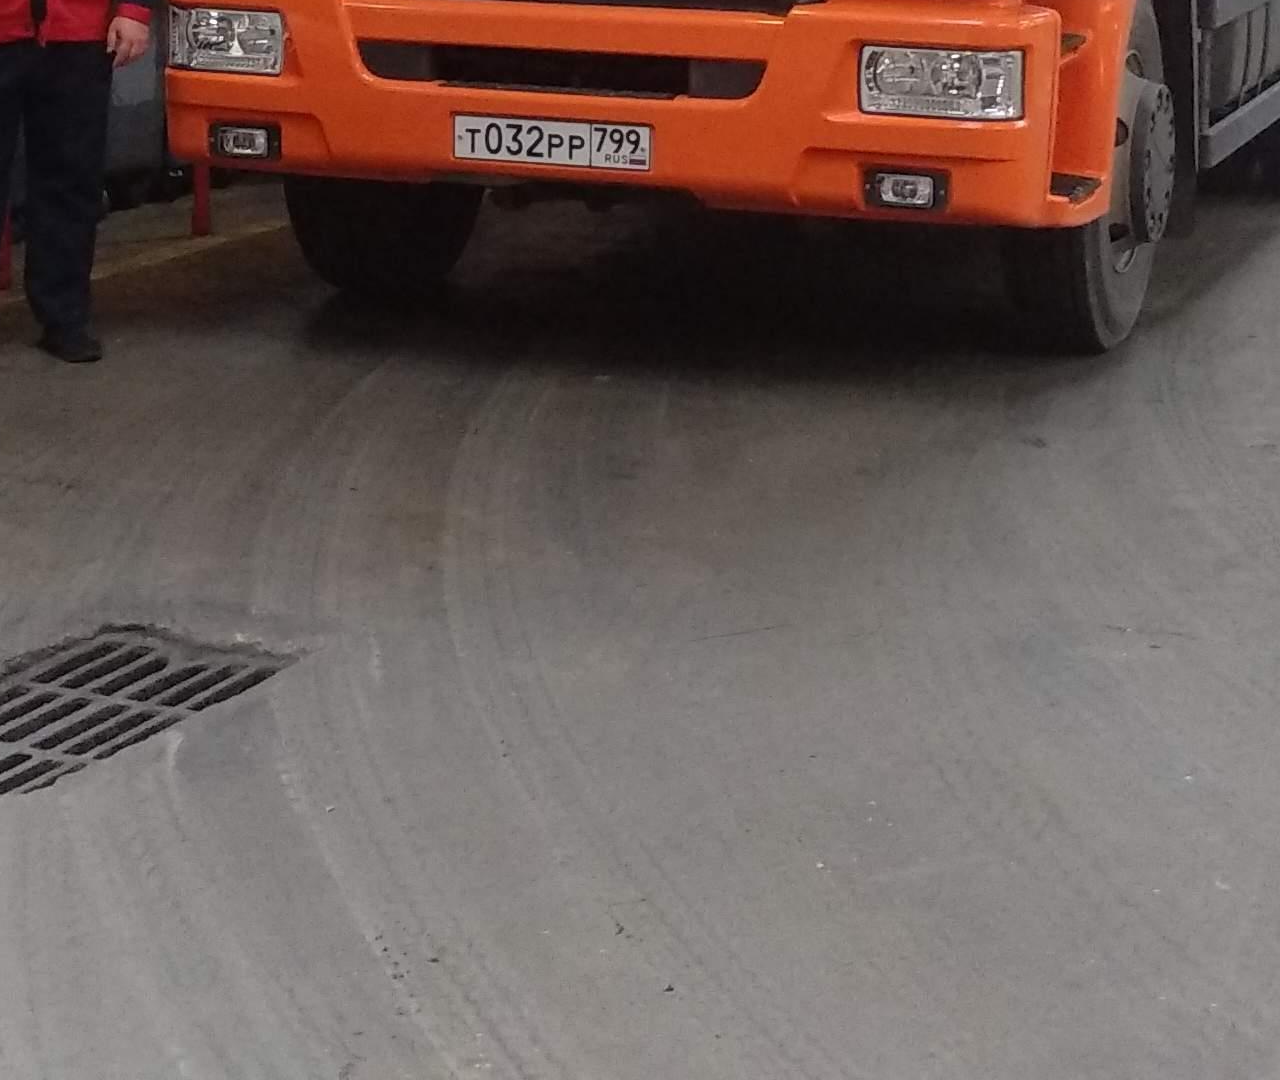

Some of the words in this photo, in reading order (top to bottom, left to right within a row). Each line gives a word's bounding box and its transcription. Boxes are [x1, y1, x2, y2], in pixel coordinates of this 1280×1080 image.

[465, 122, 585, 160] Т032РР
[593, 127, 641, 155] 799
[605, 154, 628, 165] RUS
